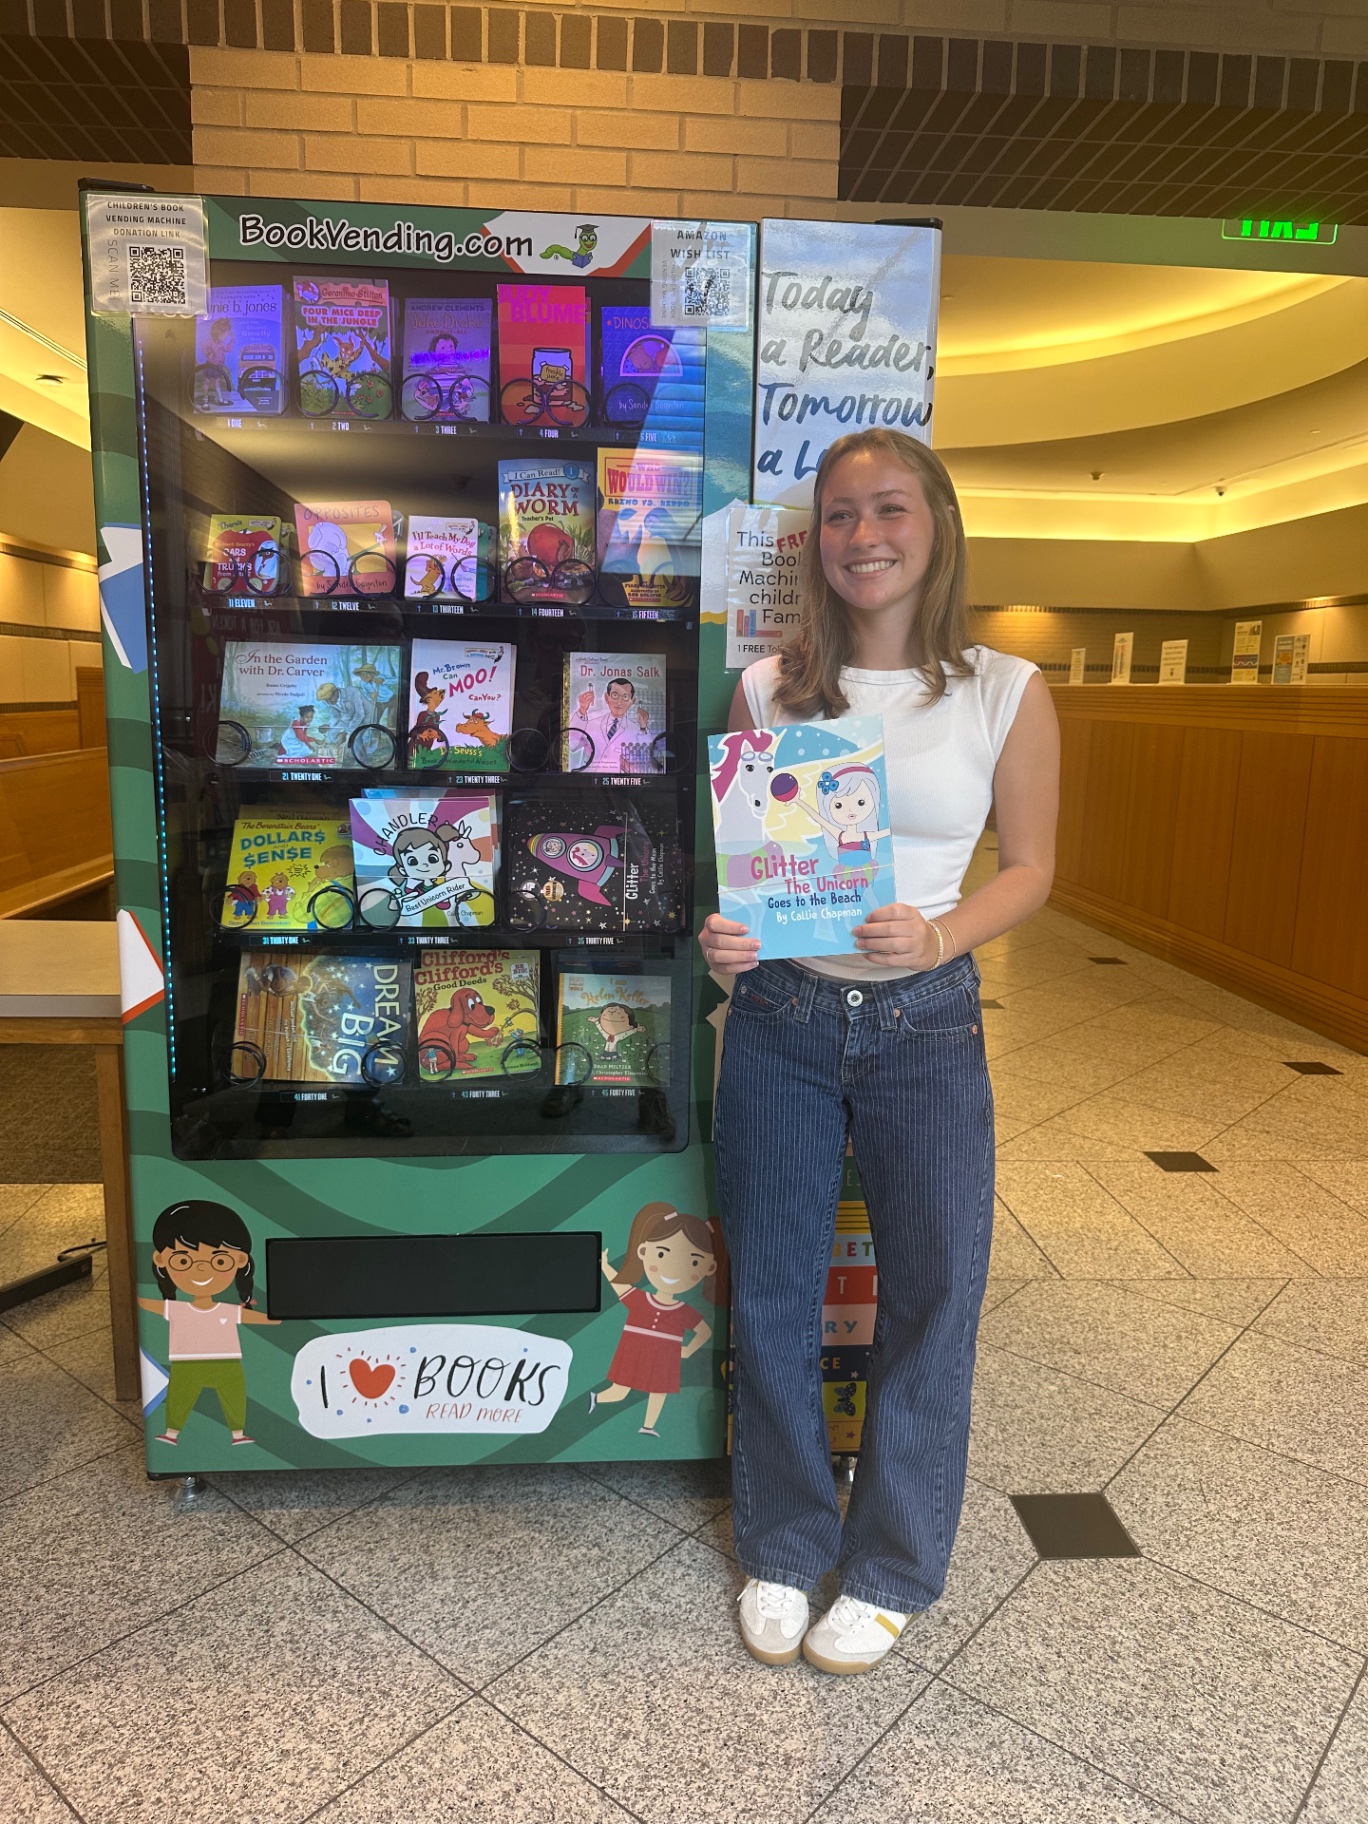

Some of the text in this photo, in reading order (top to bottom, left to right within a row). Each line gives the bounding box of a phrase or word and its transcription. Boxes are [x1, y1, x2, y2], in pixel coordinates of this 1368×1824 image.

[108, 201, 158, 210] CHILDREN'S
[106, 215, 144, 223] VENDING
[114, 228, 180, 238] DONATION LINK
[240, 215, 533, 261] BookVending.com
[677, 230, 727, 240] AMAZON
[108, 240, 118, 273] SCAN
[671, 249, 730, 259] WISH LIST
[321, 288, 383, 299] Geronimo Stilton
[243, 302, 277, 316] jones
[303, 307, 328, 315] FOUR
[332, 308, 354, 316] MICE
[498, 286, 586, 324] JUDY BLUME
[761, 271, 874, 342] Today
[341, 317, 377, 326] JUNGLE
[412, 313, 484, 329] Jake Drake
[761, 328, 934, 380] a Reader,
[619, 400, 627, 411] by
[758, 382, 933, 427] Tomorrow
[332, 422, 349, 431] 2 TWO
[436, 426, 457, 434] 3 THREE
[540, 429, 559, 438] 4 FOUR
[646, 433, 657, 441] FIVE
[757, 448, 783, 475] a
[538, 468, 560, 477] Read!
[608, 468, 690, 495] WOULD WIN?
[511, 482, 571, 498] DIARY
[303, 506, 380, 520] OPPOSITES
[513, 499, 579, 516] WORM
[412, 531, 476, 548] I'll Teach My Dog
[737, 531, 774, 547] This
[434, 543, 444, 551] of
[445, 544, 472, 556] Words
[316, 582, 326, 590] by
[235, 599, 255, 608] ELEVEN
[339, 602, 359, 610] TWELVE
[432, 605, 464, 614] 13 THIRTEEN
[532, 608, 563, 617] 14 FOURTEEN
[638, 611, 659, 619] FIFTEEN
[743, 645, 765, 653] FREE
[236, 650, 328, 665] In the Garden
[239, 666, 324, 677] with Dr. Carver
[433, 663, 470, 675] Mr. Brown
[580, 665, 660, 678] Dr. Jonas Salk
[449, 666, 497, 698] MOO!
[454, 746, 483, 756] Seuss's
[282, 772, 321, 781] 21 TWENTY ONE
[254, 822, 293, 830] Berenstain
[374, 813, 439, 856] CHANDLER
[785, 876, 869, 894] The Unicorn
[405, 883, 465, 912] Best Unicorn Rider
[768, 889, 861, 908] Goes to the Beach
[776, 906, 862, 925] By Callie Chapman
[421, 950, 510, 967] Clifford's
[415, 962, 503, 986] Clifford's
[433, 977, 487, 991] Good Deeds
[582, 987, 649, 1005] Helen Keller
[332, 1012, 375, 1075] BIG
[414, 1355, 561, 1406] BOOKS
[426, 1403, 523, 1423] READ MORE
